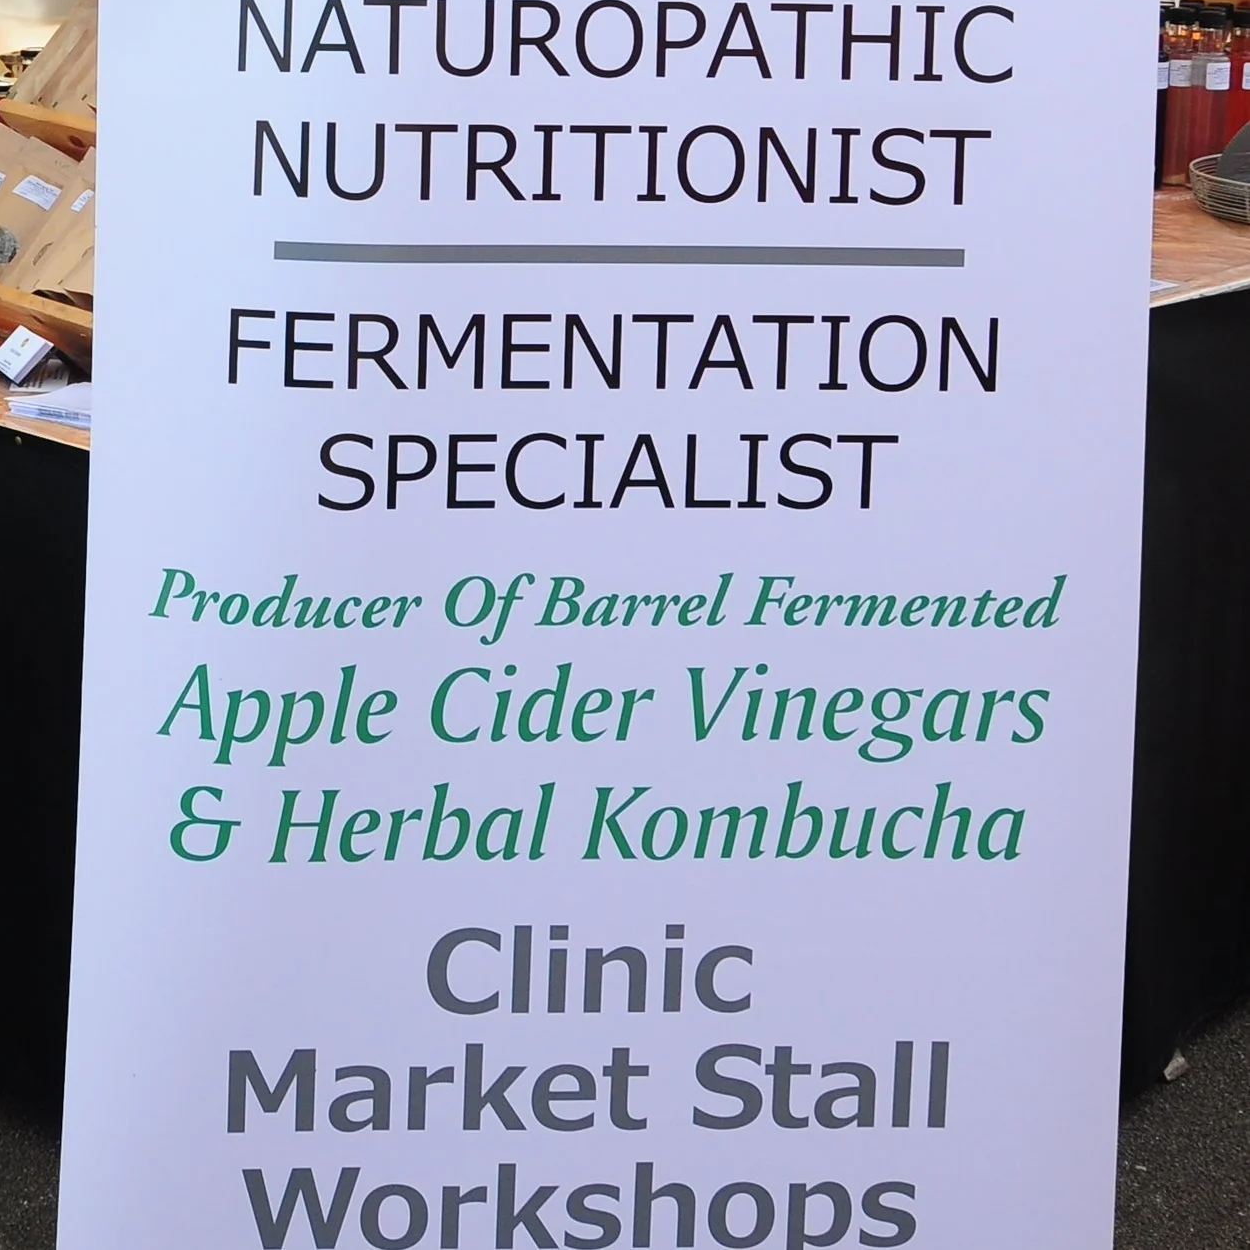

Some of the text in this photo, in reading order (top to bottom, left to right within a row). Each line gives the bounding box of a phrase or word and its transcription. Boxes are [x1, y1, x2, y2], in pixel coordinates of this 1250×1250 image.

[253, 119, 992, 206] NUTRITIONIST
[227, 307, 999, 393] FERMENTATION
[317, 432, 900, 512] SPECIALIST
[147, 568, 1068, 646] Producer Of Barrel Fermented
[155, 661, 1051, 768] Apple Cider Vinegars
[169, 780, 1026, 864] & Herbal Kombucha
[426, 923, 754, 1016] Clinic
[226, 1040, 950, 1134] Market Stall
[241, 1161, 917, 1250] Workshops
